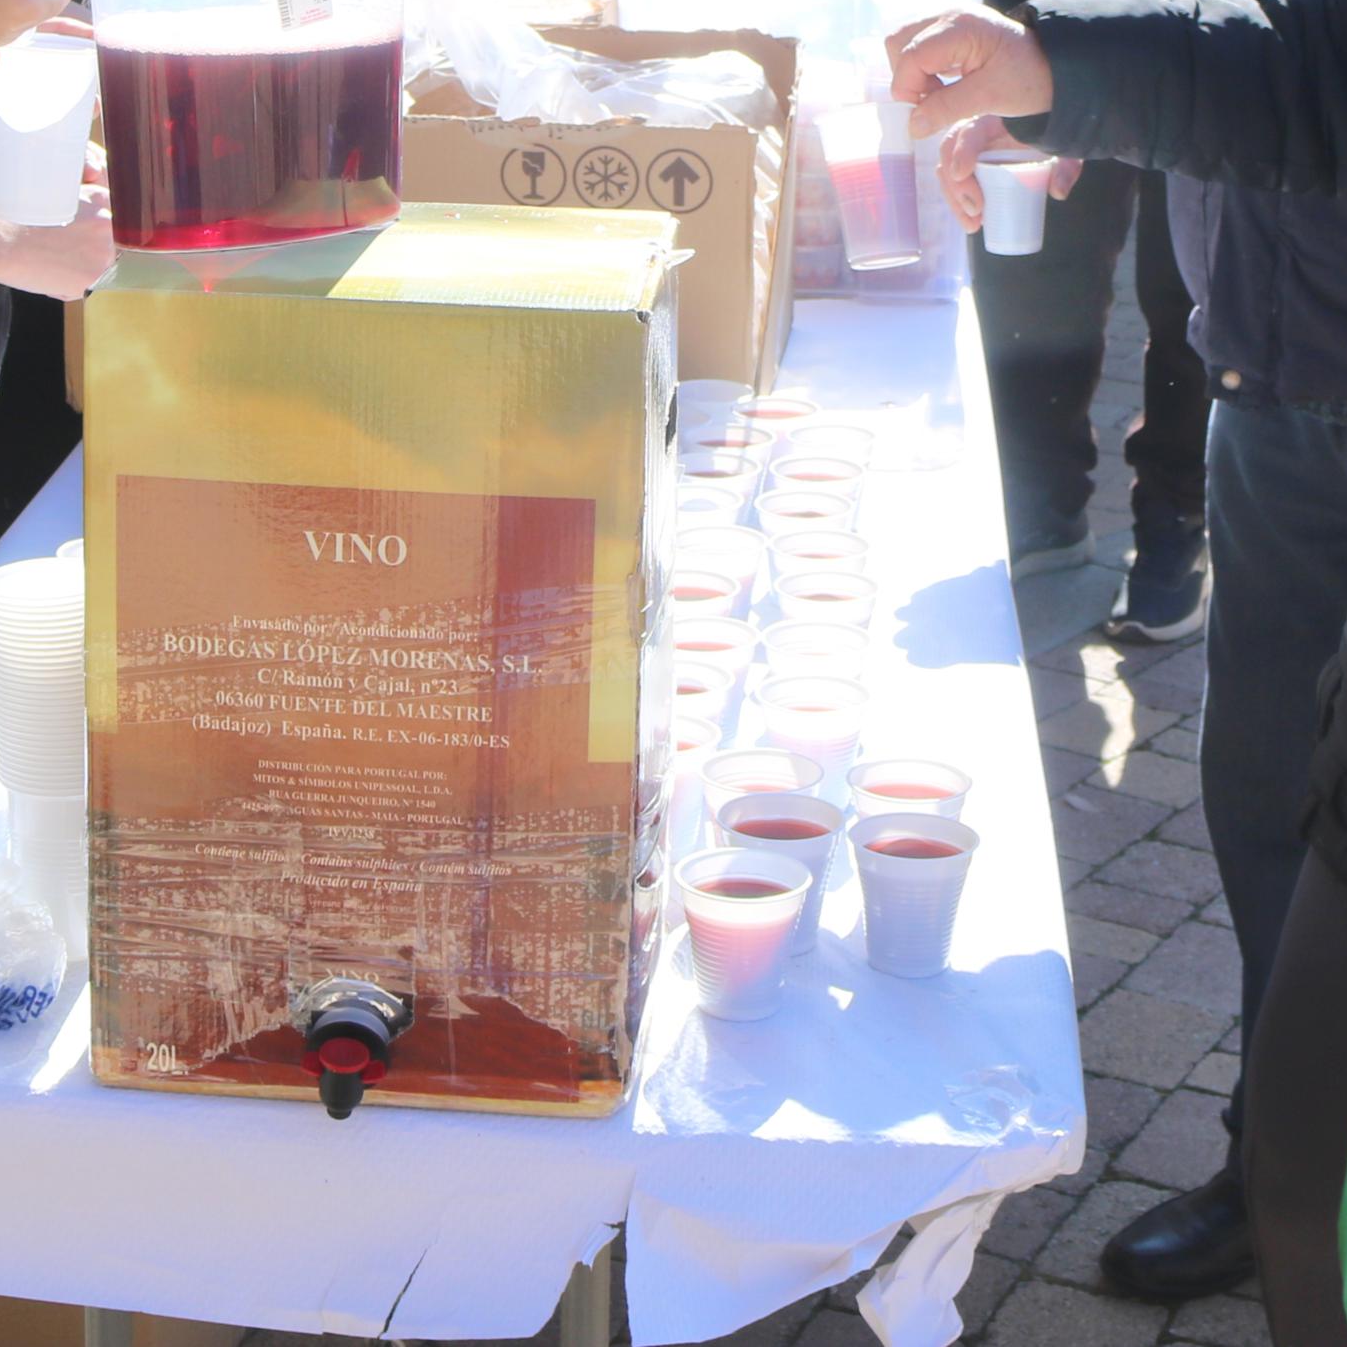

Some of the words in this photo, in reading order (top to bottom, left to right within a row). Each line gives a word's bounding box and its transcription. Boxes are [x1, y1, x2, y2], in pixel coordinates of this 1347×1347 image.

[303, 530, 408, 566] VINO
[232, 615, 299, 633] Envasado
[303, 623, 326, 637] por
[339, 623, 444, 640] Acondicionado
[448, 629, 479, 644] por:
[164, 633, 276, 659] BODEGAS
[283, 639, 361, 666] LÓPEZ
[368, 649, 496, 675] MORENAS,
[502, 654, 542, 674] S.L.
[257, 667, 278, 684] C/
[283, 669, 343, 688] Ramón
[347, 678, 358, 693] y
[363, 674, 415, 695] Cajal,
[216, 690, 264, 708] 06360
[269, 694, 346, 715] FUENTE
[352, 699, 392, 717] DEL
[397, 702, 493, 722] MAESTRE
[192, 714, 271, 736] (Badajoz)
[281, 720, 347, 740] España.
[352, 727, 383, 741] R.E.
[252, 773, 285, 785] MITOS
[287, 776, 296, 786] &
[335, 765, 361, 776] PARA
[364, 766, 420, 779] PORTUGAL
[423, 770, 448, 780] POR:
[268, 789, 290, 800] RUA
[291, 791, 334, 803] GUERRA
[324, 808, 363, 820] SANTAS
[372, 811, 399, 822] MAIA
[407, 813, 464, 826] PORTUGAL
[195, 842, 246, 859] Contiene
[301, 852, 354, 868] Contains
[419, 860, 464, 875] Contém
[280, 870, 349, 888] Producido
[351, 879, 368, 889] en
[372, 877, 422, 892] España
